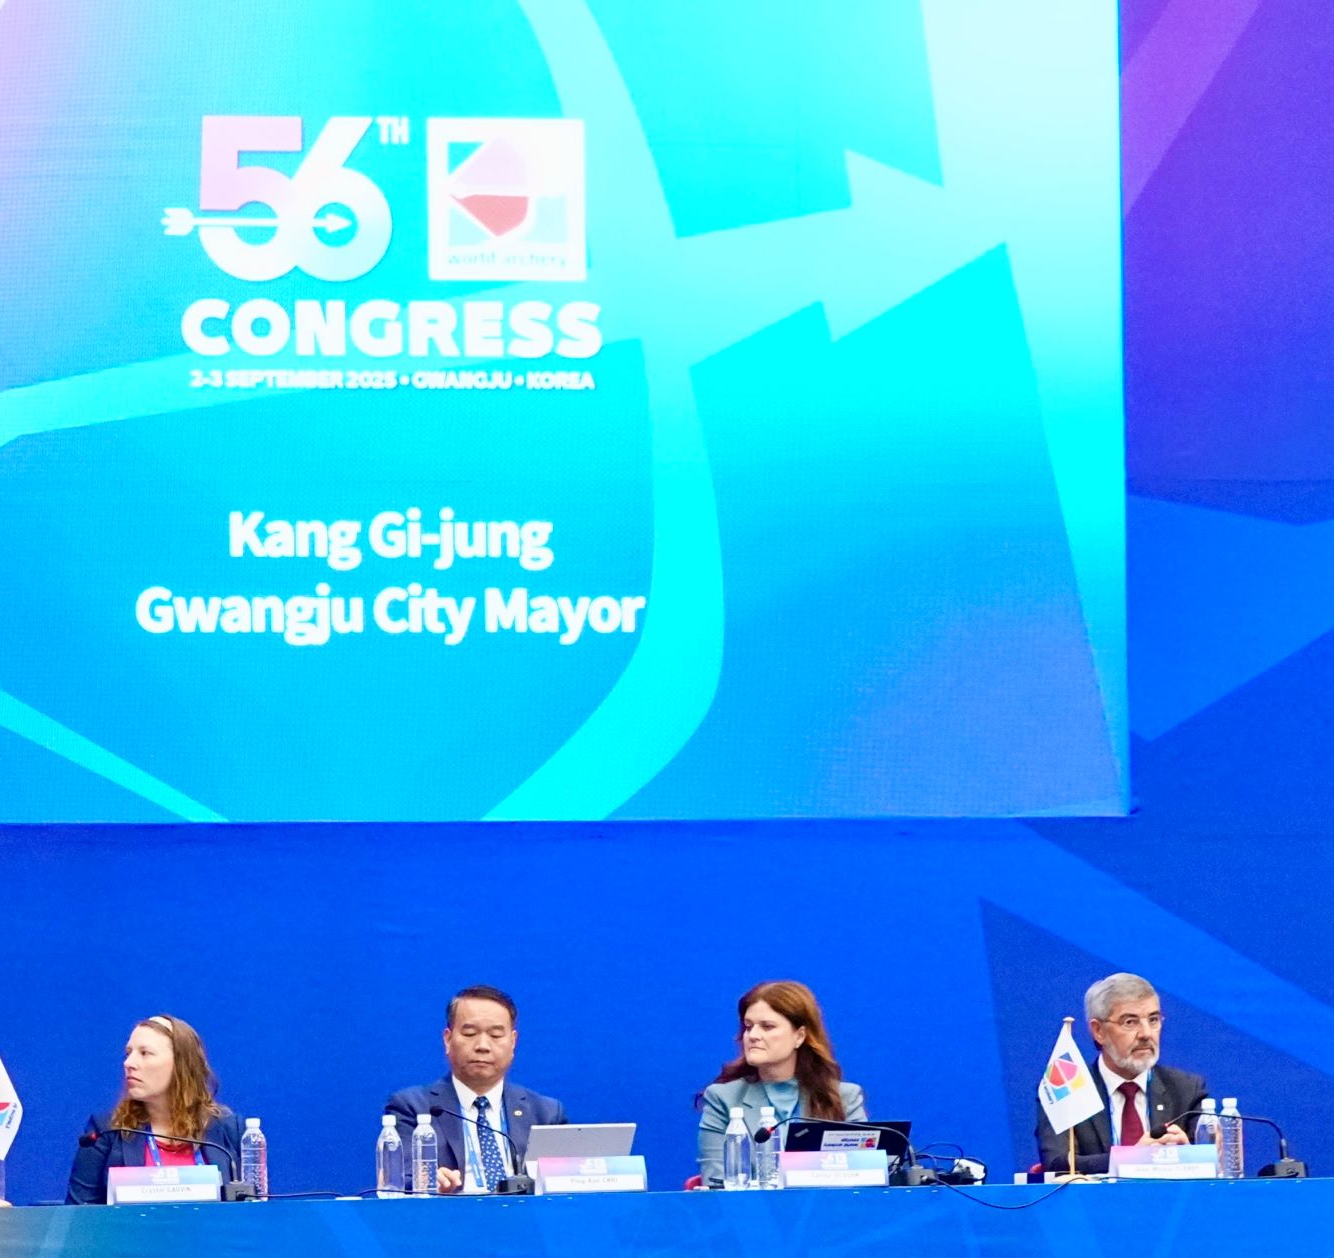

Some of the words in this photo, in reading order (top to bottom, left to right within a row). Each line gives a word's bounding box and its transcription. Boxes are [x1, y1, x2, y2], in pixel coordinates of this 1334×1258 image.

[181, 298, 604, 359] CONGRESS
[189, 369, 223, 389] 2-3
[226, 370, 344, 389] SEPTEMBER
[345, 370, 398, 390] 2025
[411, 371, 513, 391] GWANGJU
[526, 372, 596, 391] KOREA
[228, 510, 363, 572] Kang
[368, 506, 554, 572] Gi-jung
[135, 582, 365, 647] Gwangju
[373, 582, 476, 647] City
[485, 587, 647, 646] Mayor
